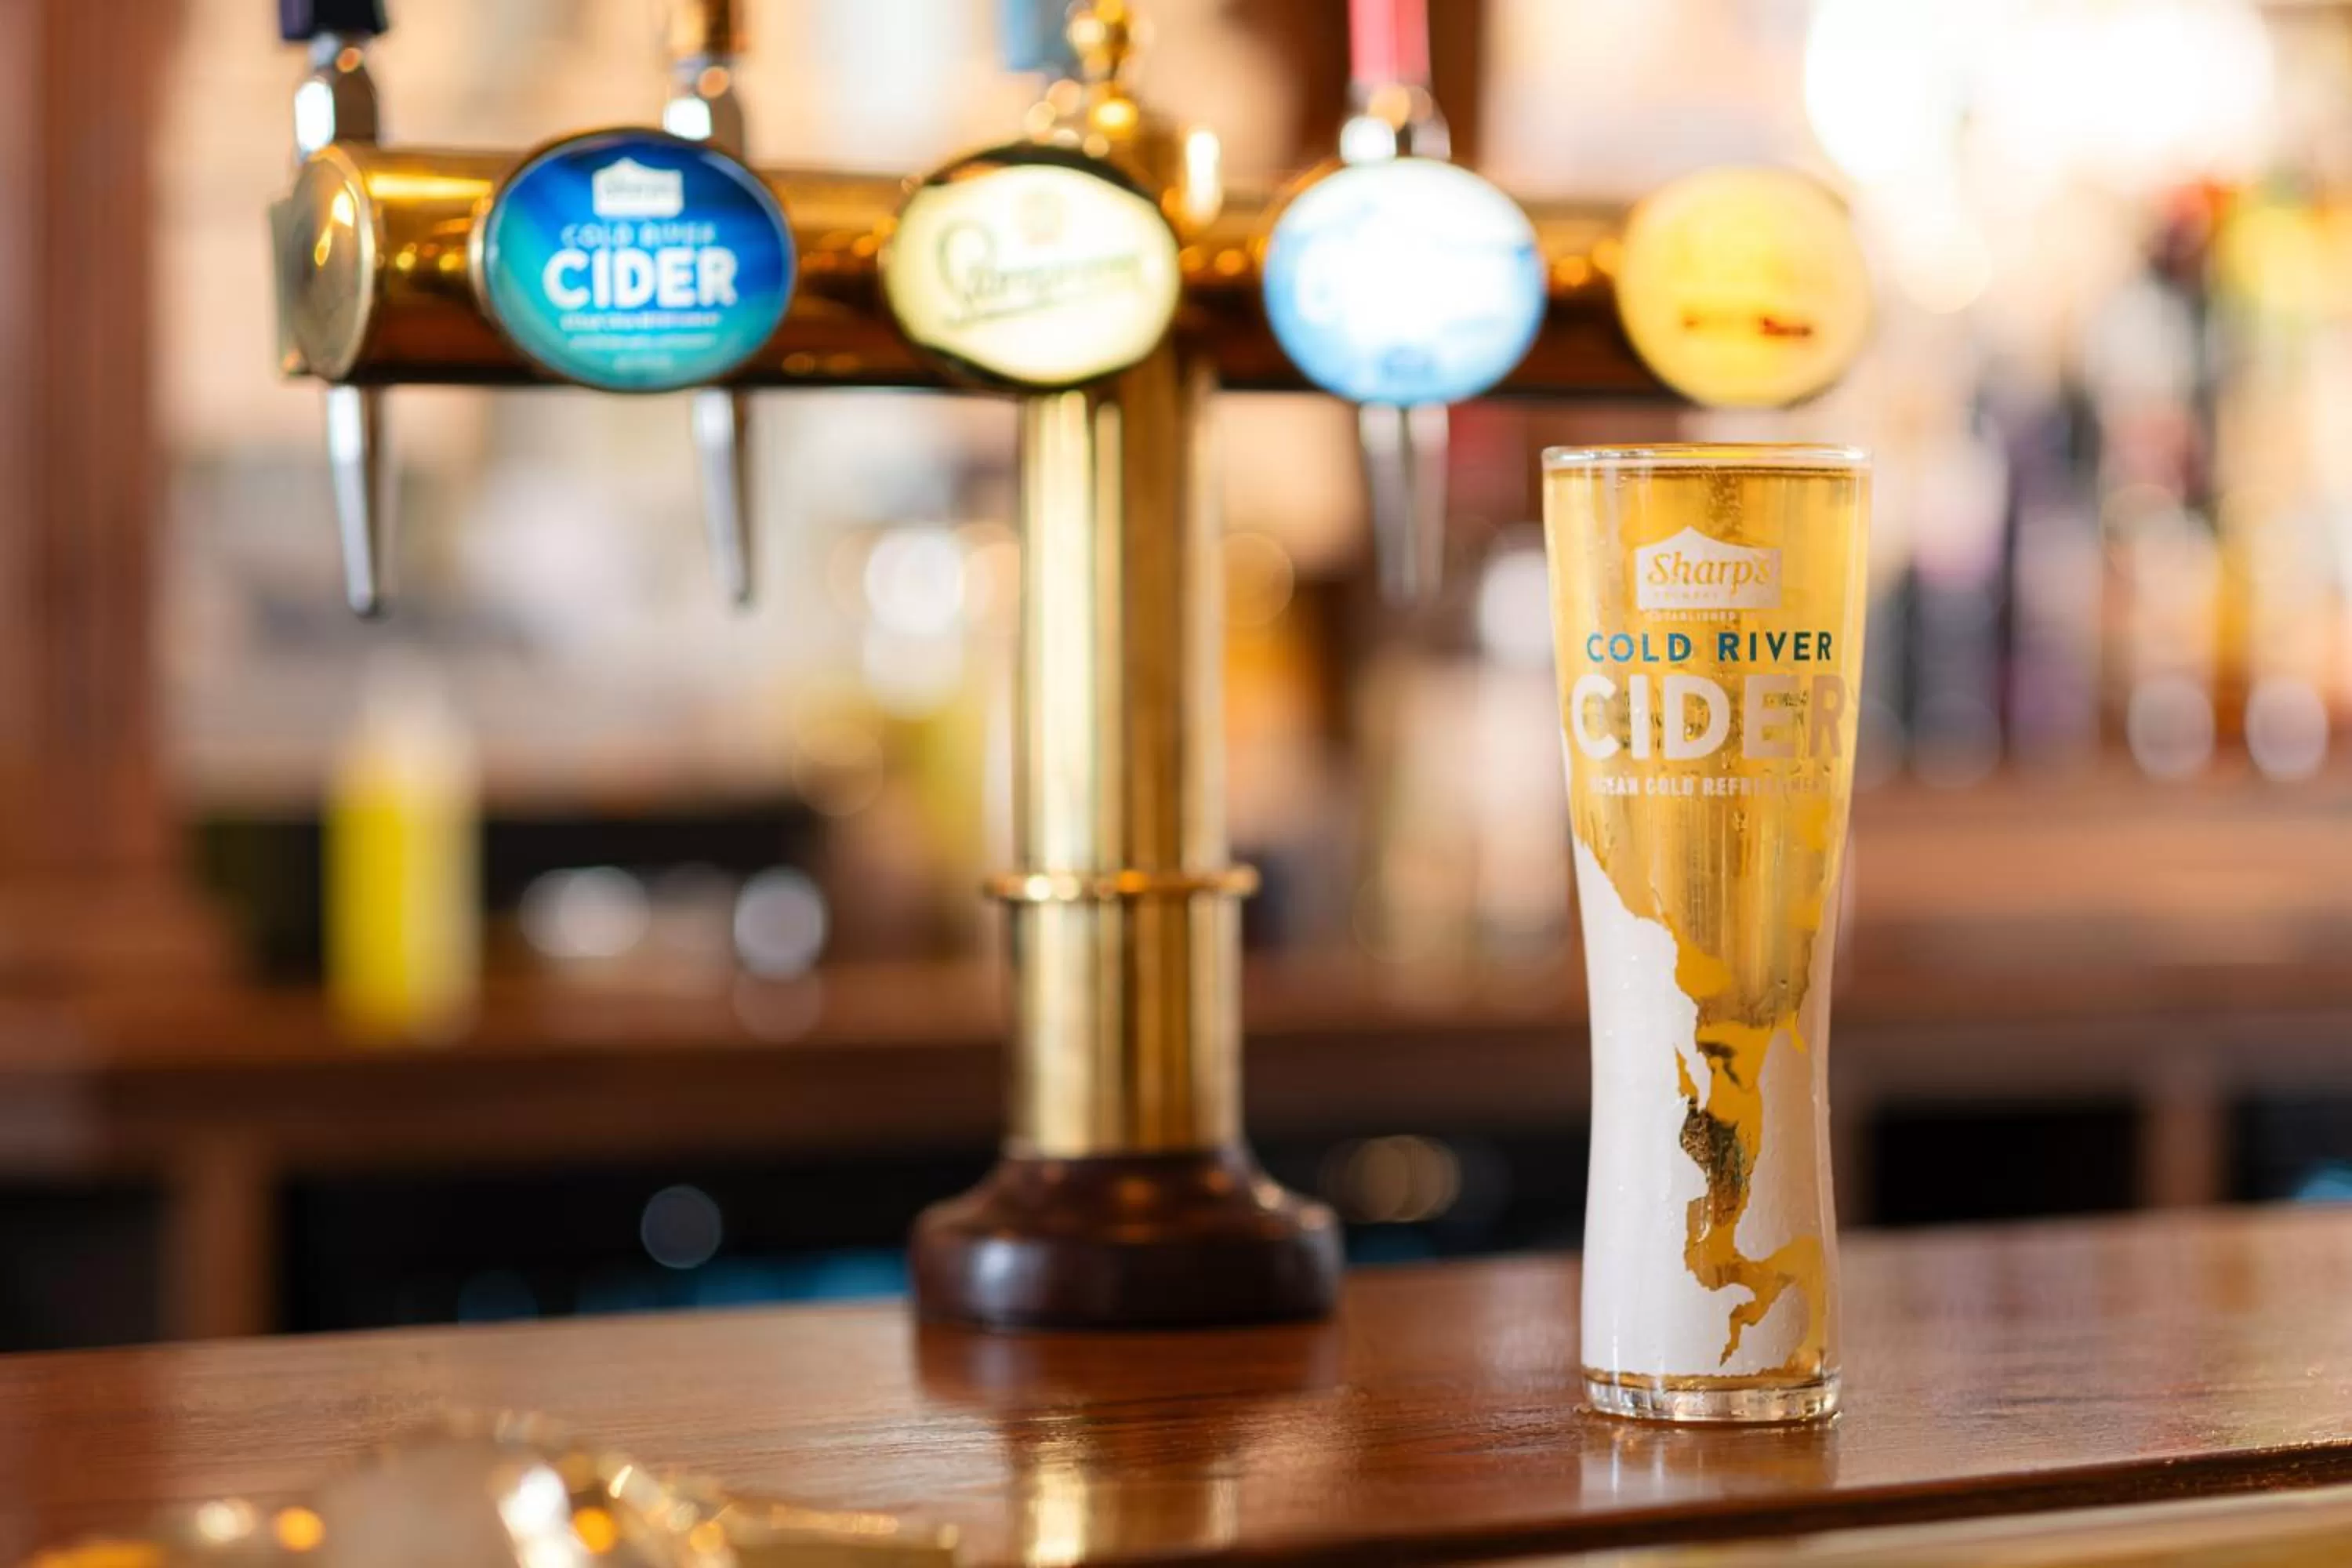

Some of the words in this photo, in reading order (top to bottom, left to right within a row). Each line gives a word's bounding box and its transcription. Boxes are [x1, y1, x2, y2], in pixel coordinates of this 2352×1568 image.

[543, 246, 739, 310] CIDER
[1648, 550, 1770, 597] Sharp's
[1587, 632, 1693, 663] COLD
[1718, 631, 1833, 662] RIVER
[1571, 673, 1846, 760] CIDER
[1646, 777, 1694, 797] COLD
